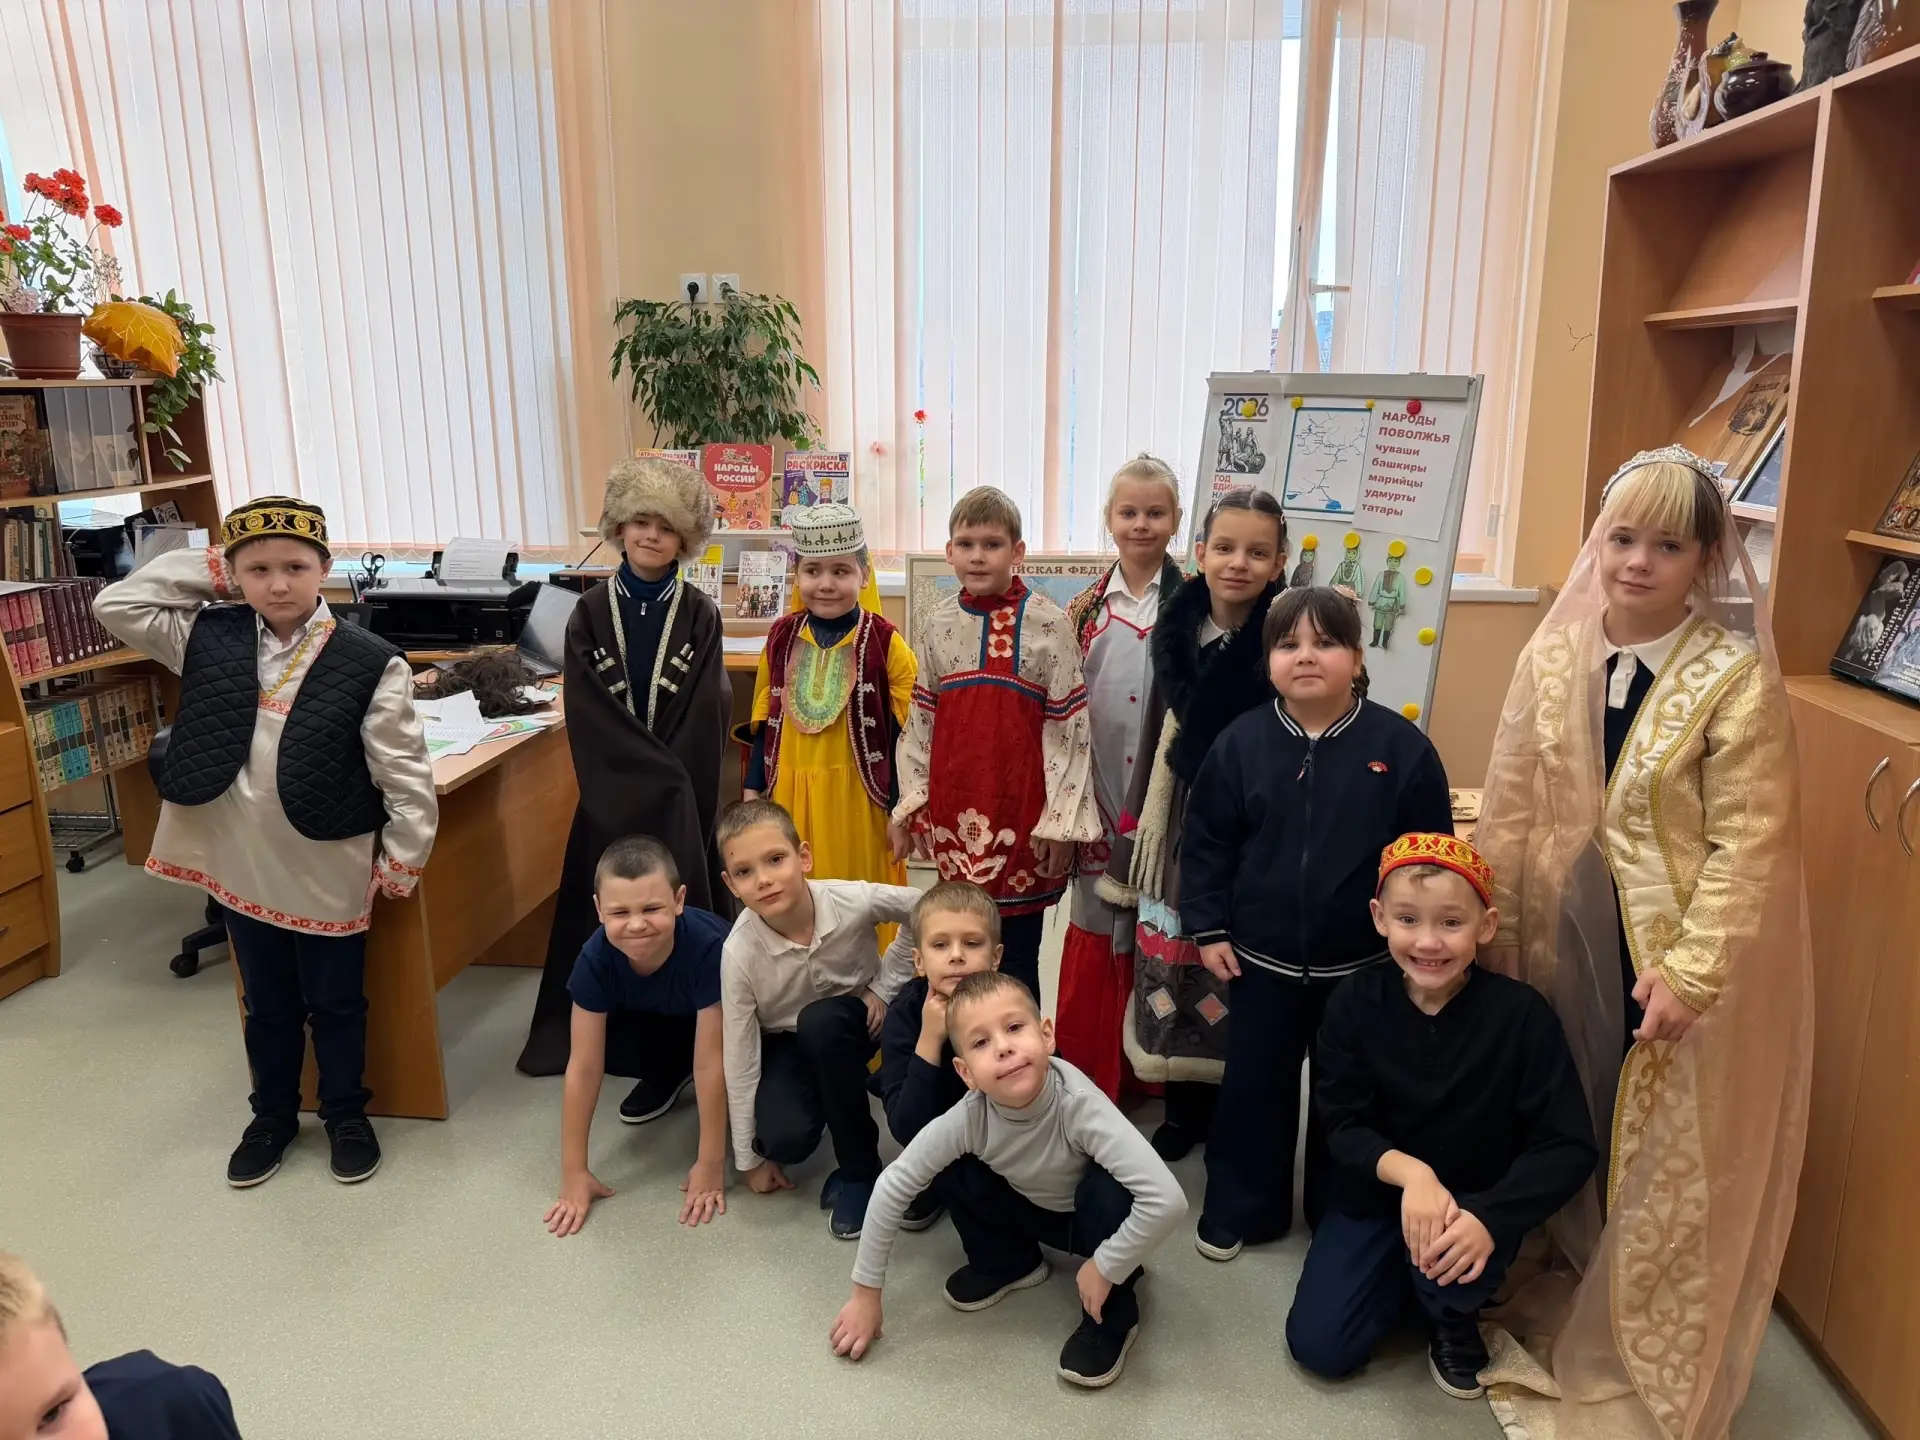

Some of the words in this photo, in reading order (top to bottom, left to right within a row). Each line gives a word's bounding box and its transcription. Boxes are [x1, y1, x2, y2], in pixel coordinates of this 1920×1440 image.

[1382, 411, 1437, 427] НАРОДЫ
[1378, 426, 1451, 444] ПОВОЛЖЬЯ
[1375, 443, 1420, 457] чуваши
[714, 463, 759, 474] НАРОДЫ
[786, 460, 847, 470] РАСКРАСКА
[1371, 457, 1427, 473] башкиры
[716, 474, 756, 483] РОССИИ
[1214, 474, 1231, 483] ГОД
[1368, 473, 1423, 489] марийцы
[1364, 488, 1416, 503] удмурты
[1361, 503, 1404, 517] татары
[1068, 566, 1110, 576] ФЕДЕ
